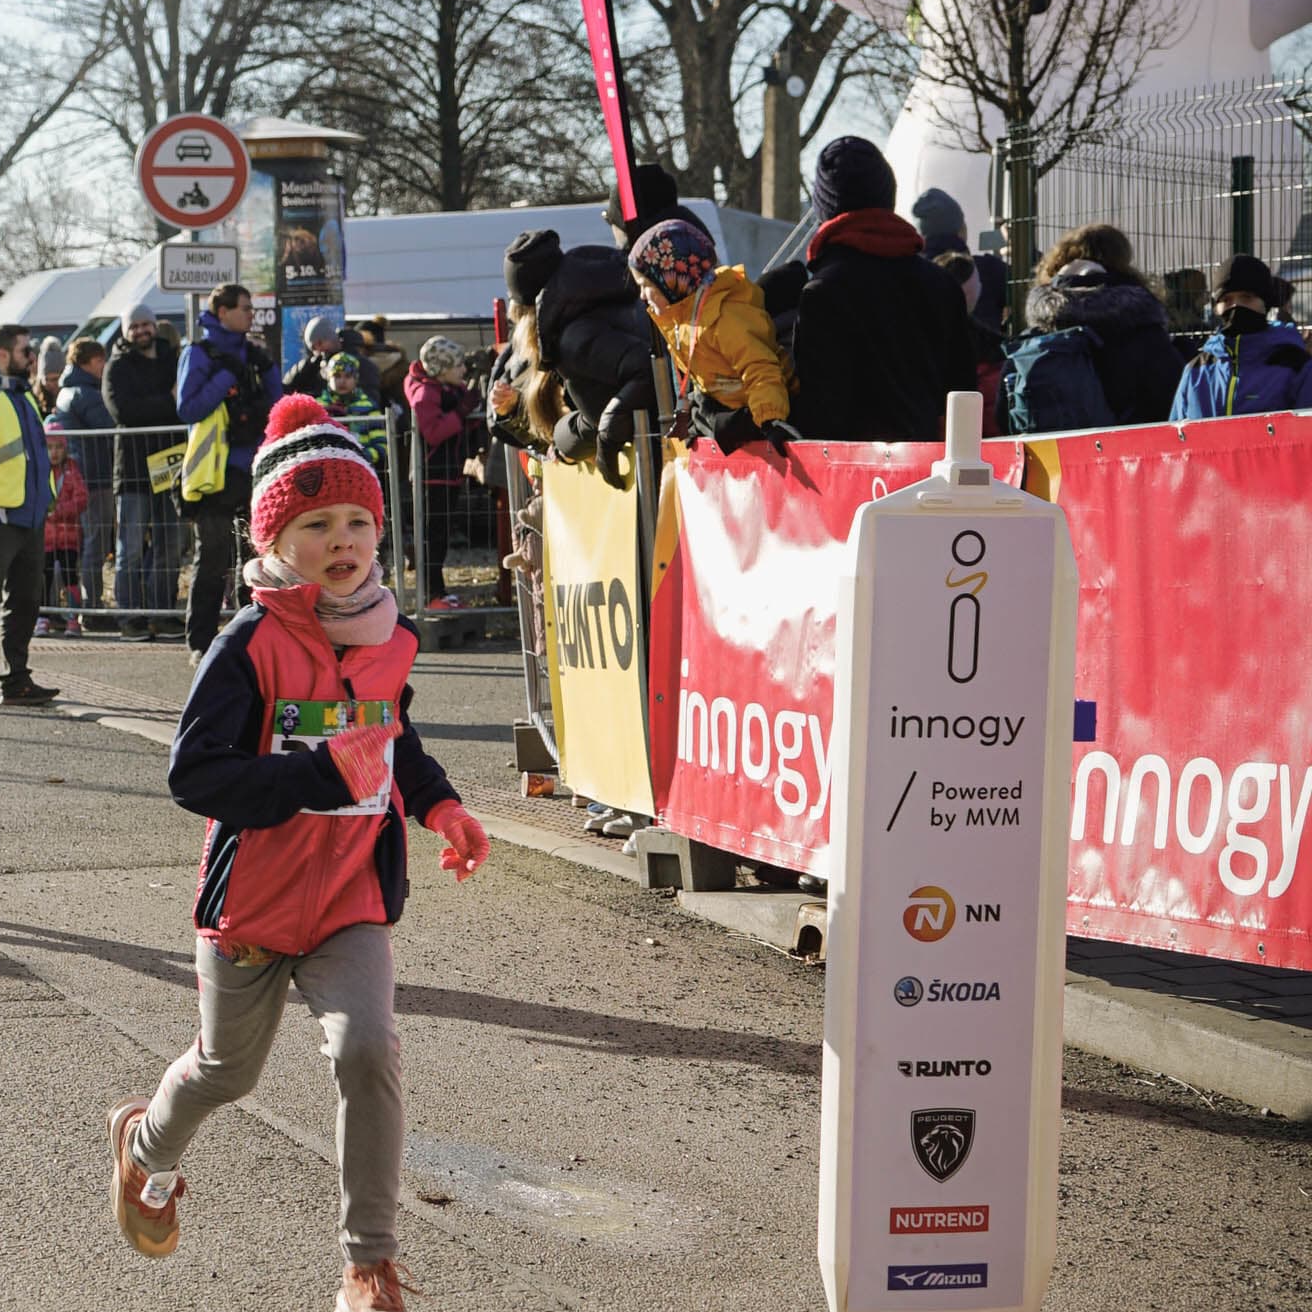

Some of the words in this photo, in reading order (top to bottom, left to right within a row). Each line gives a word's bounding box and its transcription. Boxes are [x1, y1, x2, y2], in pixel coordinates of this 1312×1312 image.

[186, 252, 215, 265] MIMO
[891, 705, 1025, 746] innogy
[677, 658, 833, 820] innogy
[932, 780, 1023, 800] Powered
[930, 807, 956, 832] by
[966, 808, 1020, 826] MVM
[1070, 751, 1312, 898] nnogy
[965, 904, 1001, 922] NN
[927, 979, 1001, 1002] ŠKODA
[916, 1060, 992, 1077] RUNTO
[895, 1212, 985, 1228] NUTREND
